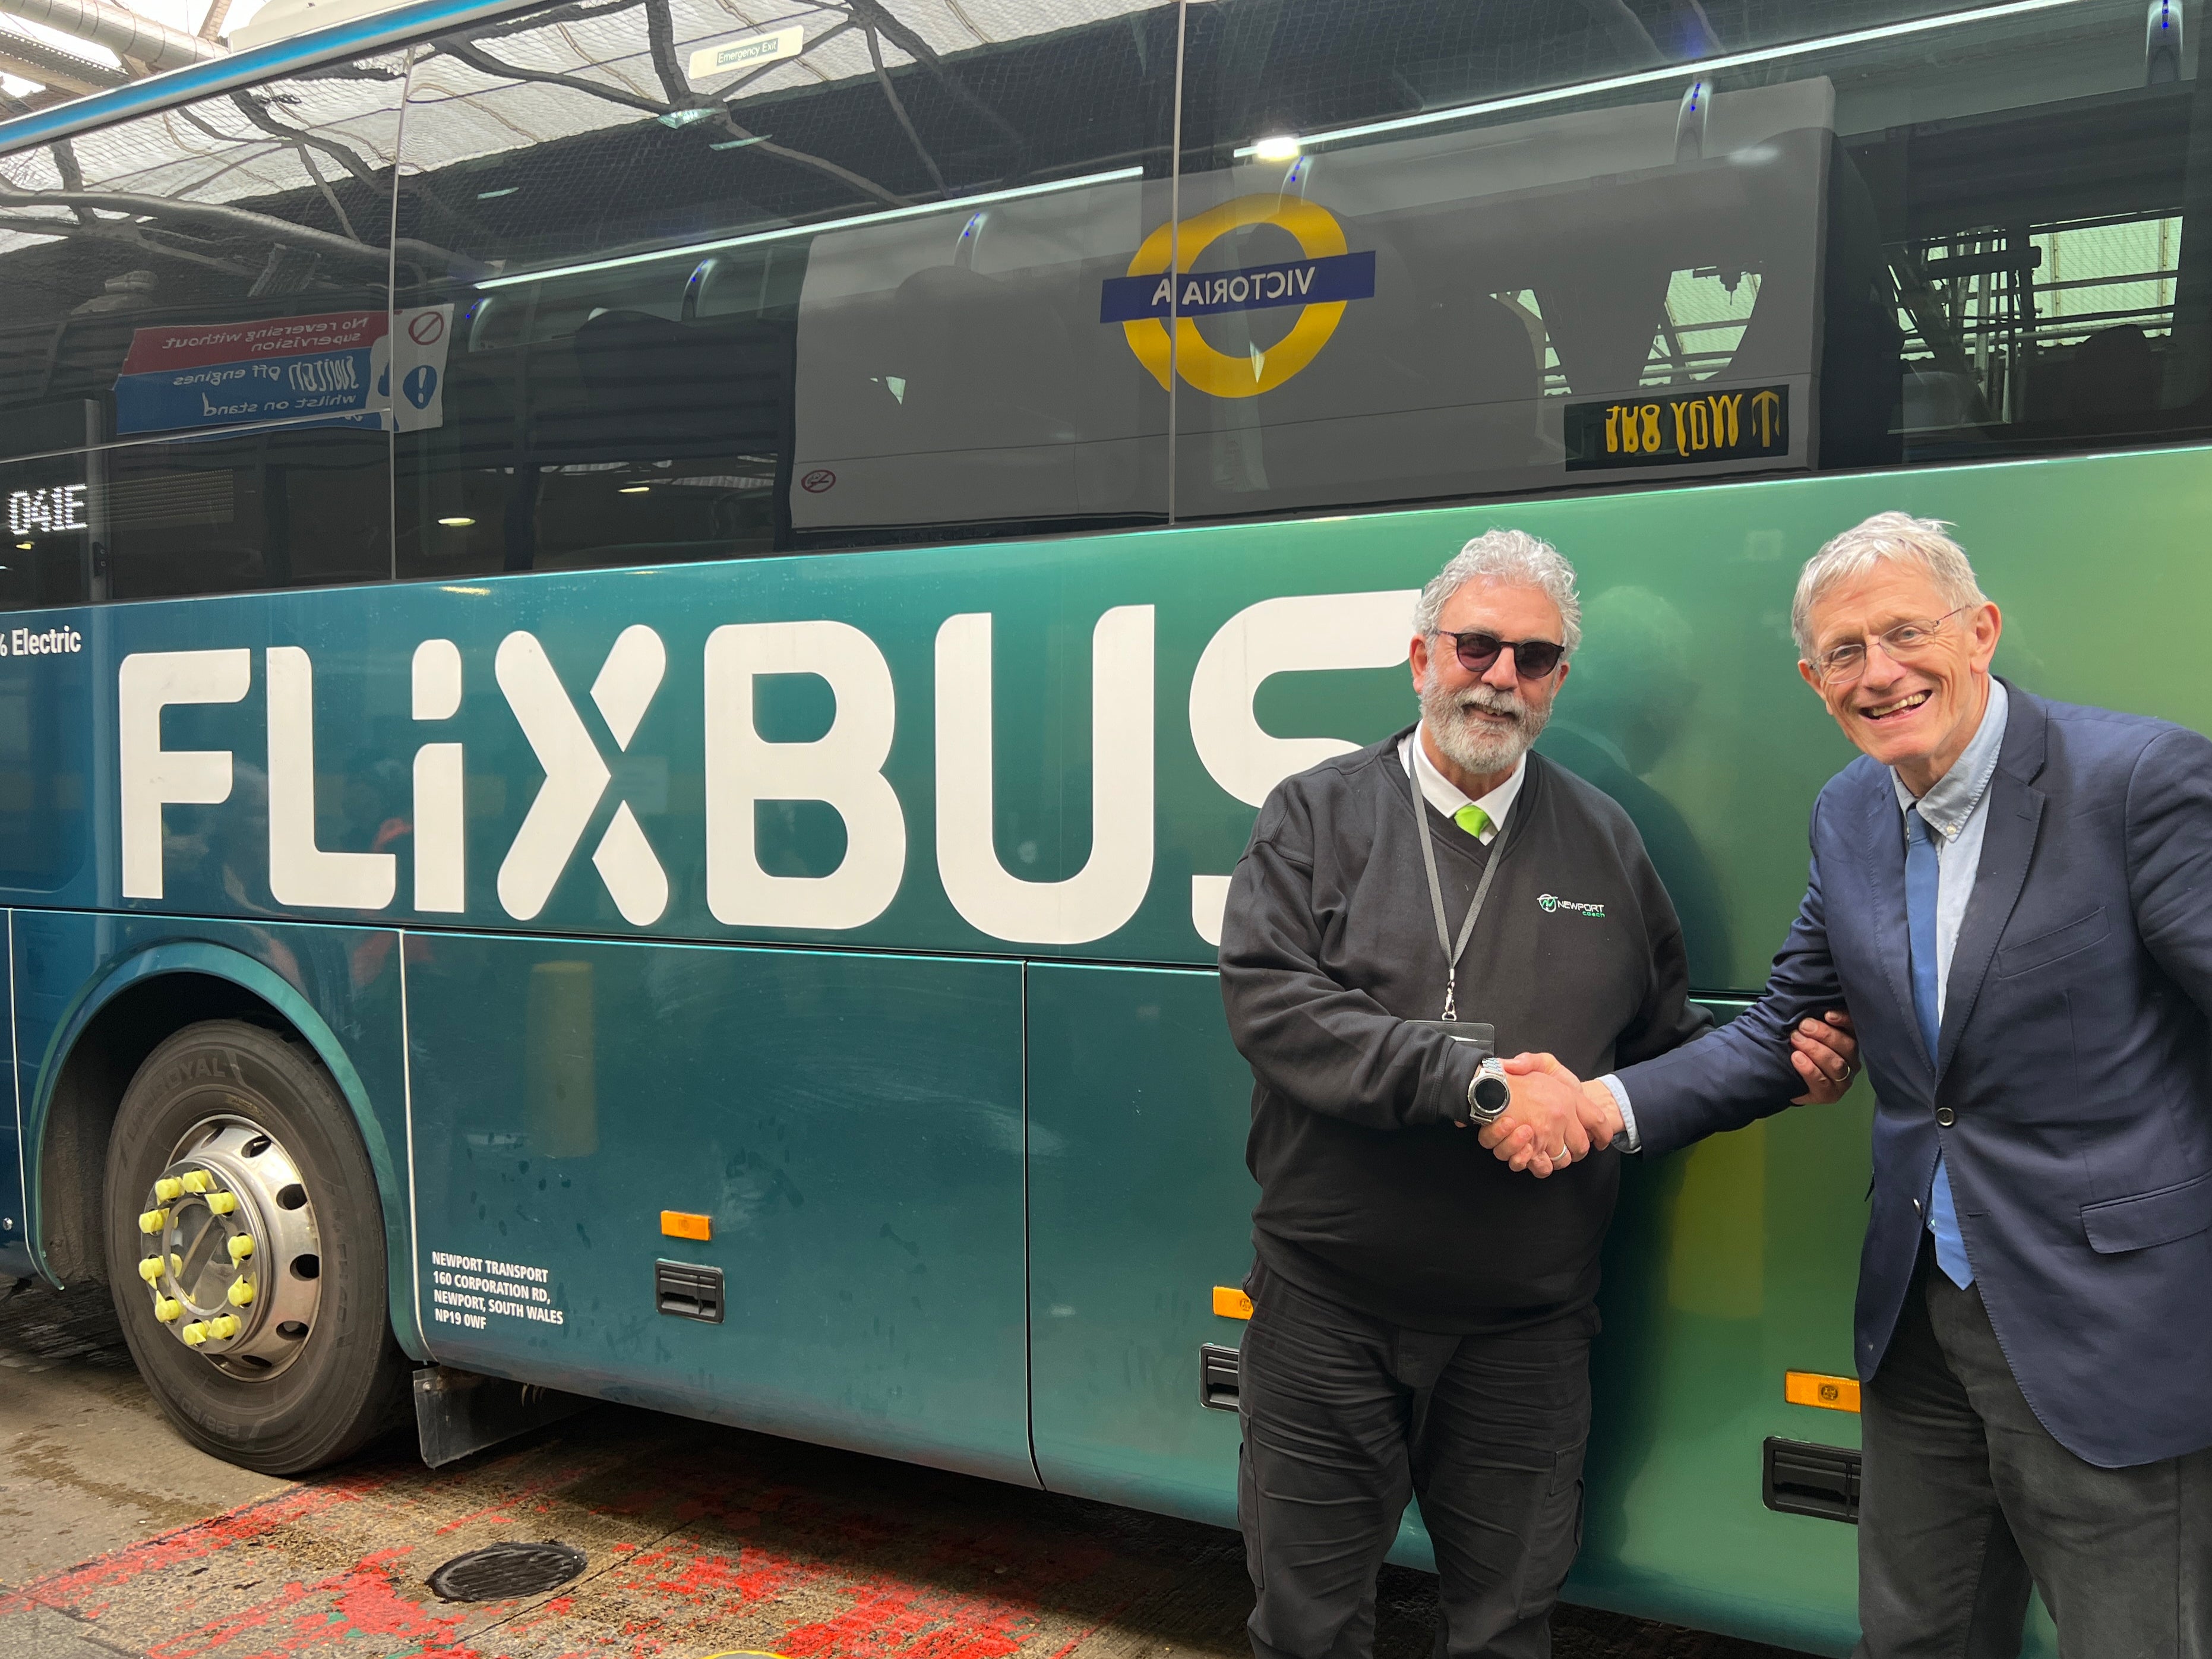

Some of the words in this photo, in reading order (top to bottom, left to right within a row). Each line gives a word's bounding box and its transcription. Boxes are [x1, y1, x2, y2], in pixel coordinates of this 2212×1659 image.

[718, 45, 760, 64] Emergency
[762, 40, 777, 53] Exit
[8, 482, 88, 535] 041E
[12, 625, 82, 656] Electric
[1557, 900, 1604, 913] NEWPORT
[431, 1251, 483, 1272] NEWPORT
[485, 1259, 548, 1283] TRANSPORT
[433, 1270, 452, 1286] 160
[454, 1274, 529, 1300] CORPORATION
[532, 1287, 551, 1305] RD,
[434, 1289, 486, 1312] NEWPORT,
[488, 1298, 524, 1318] SOUTH
[526, 1305, 564, 1325] WALES
[435, 1308, 462, 1326] NP19
